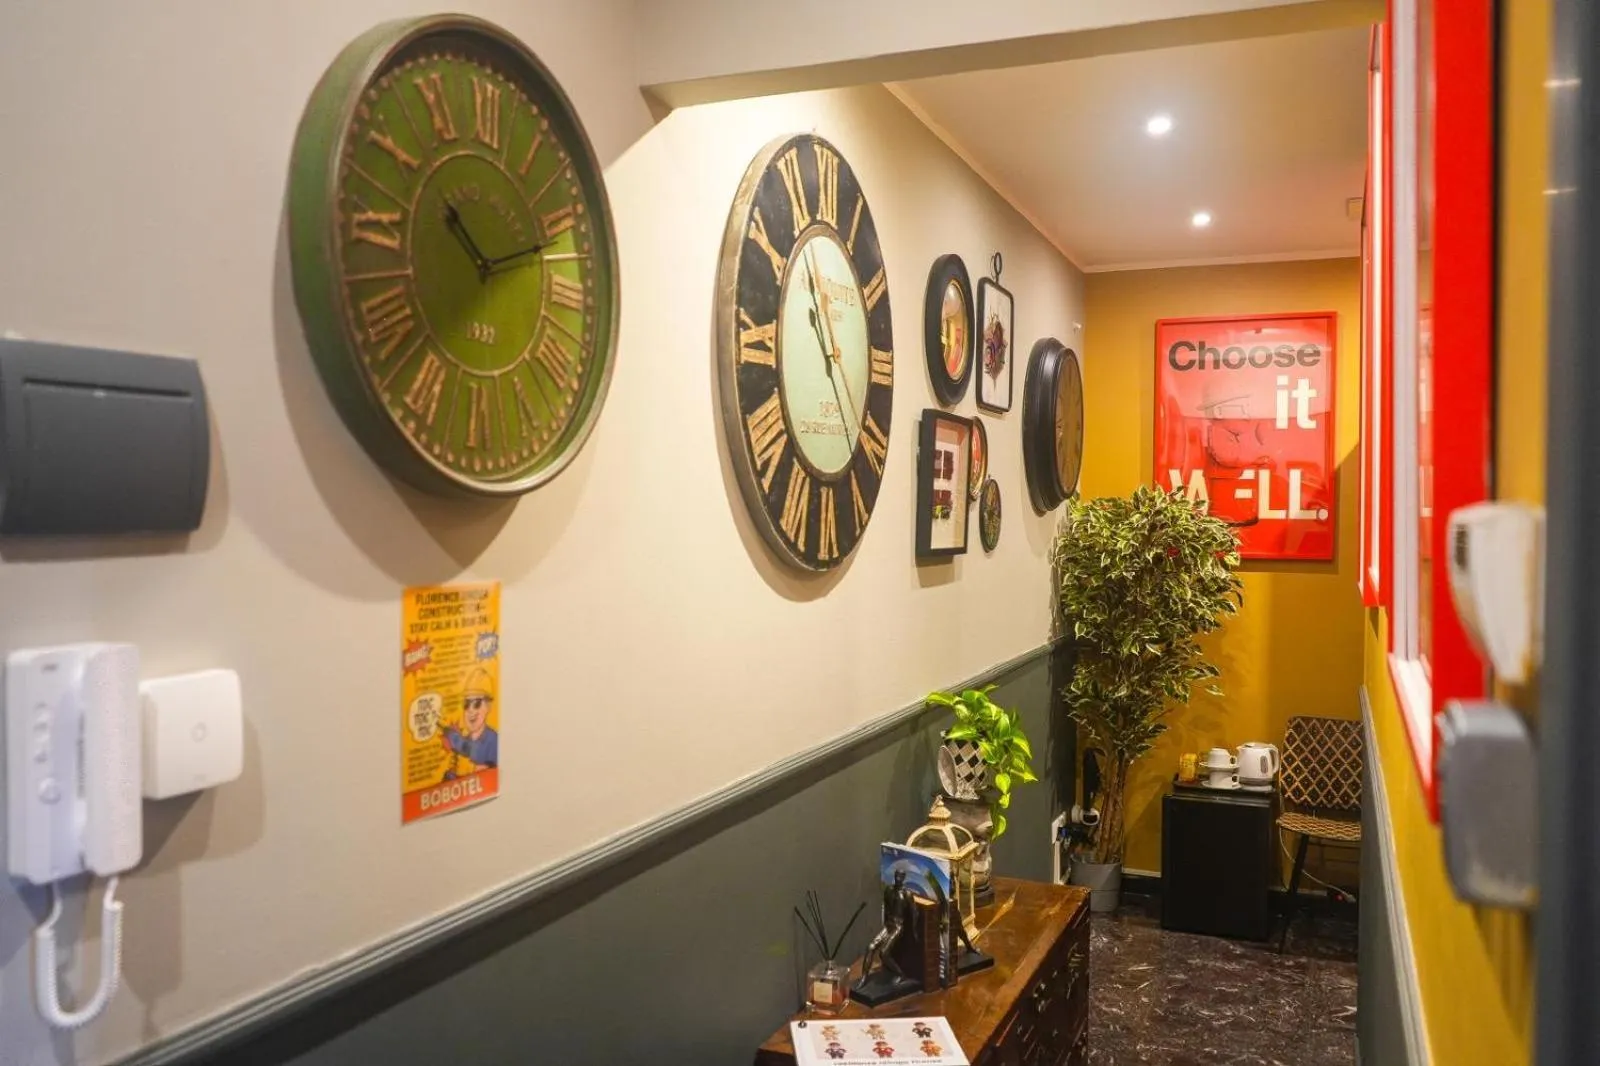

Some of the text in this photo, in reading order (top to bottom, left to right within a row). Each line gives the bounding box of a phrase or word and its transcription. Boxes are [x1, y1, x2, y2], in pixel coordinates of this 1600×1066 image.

[471, 76, 501, 150] XII
[776, 146, 812, 238] XI
[813, 143, 840, 230] XII
[540, 205, 576, 239] II
[846, 193, 864, 256] I
[550, 273, 584, 310] III
[862, 265, 887, 313] II
[870, 345, 894, 388] III
[1168, 340, 1321, 371] Choose
[1276, 375, 1317, 429] it
[779, 456, 811, 553] VII
[817, 485, 840, 561] VI
[421, 777, 483, 811] BOBOTEL
